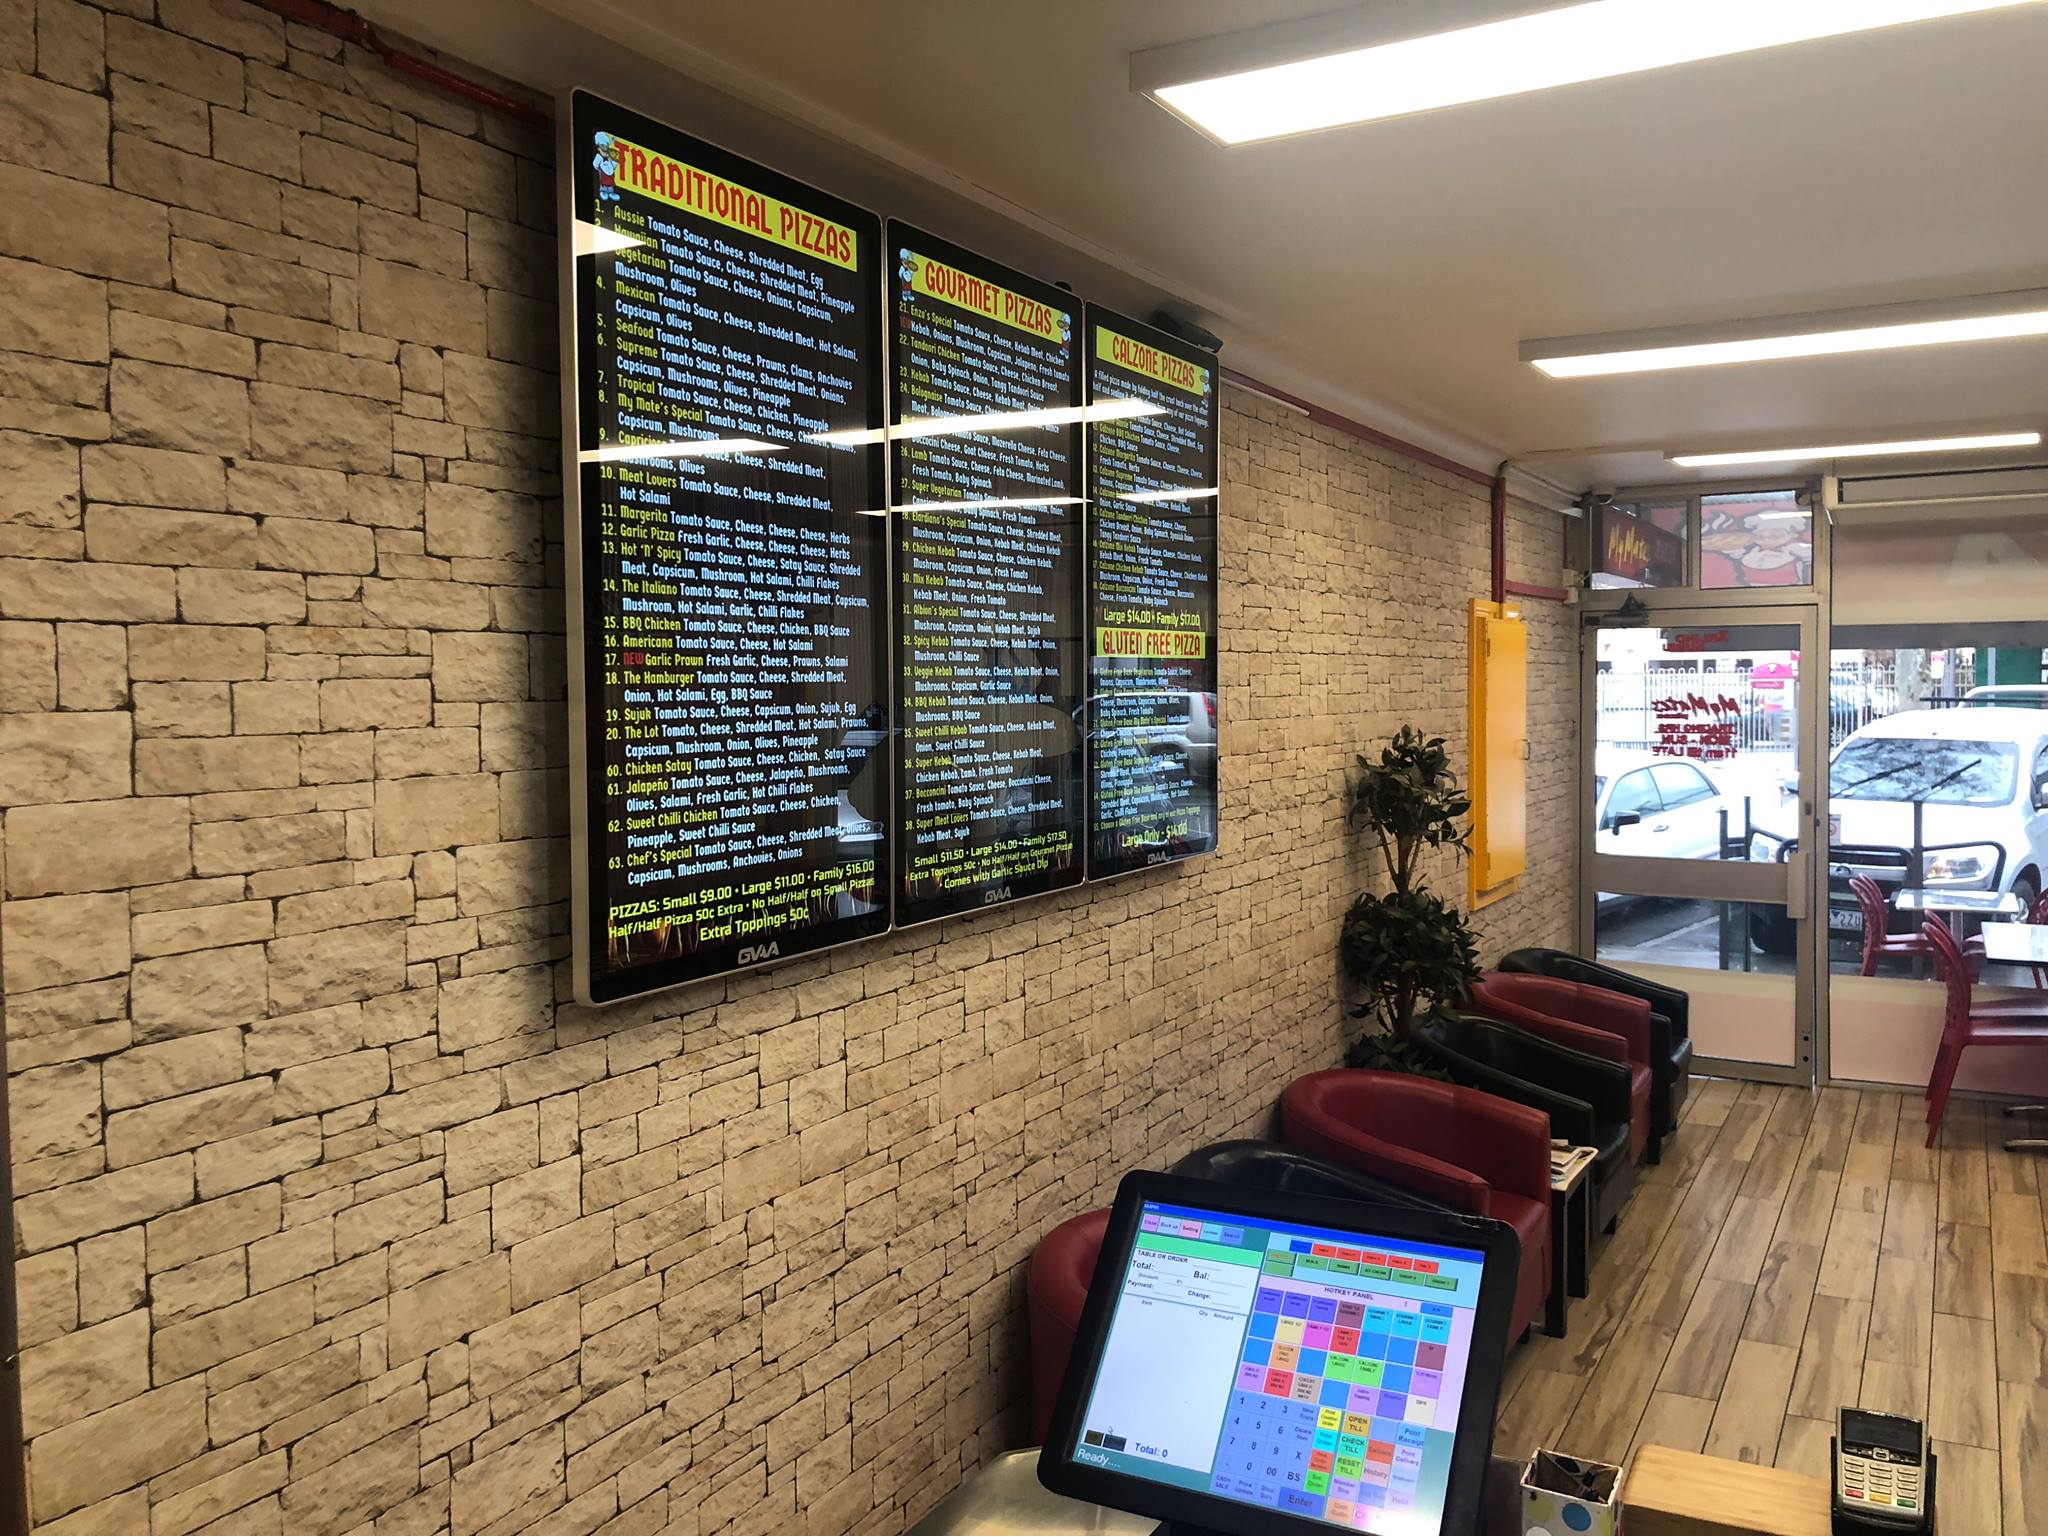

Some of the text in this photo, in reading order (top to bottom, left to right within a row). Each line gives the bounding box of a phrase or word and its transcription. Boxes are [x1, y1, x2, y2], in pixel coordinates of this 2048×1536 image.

[614, 140, 851, 263] TRADITIONAL PIZZAS
[594, 197, 824, 290] 1. Aussie Tomato Sauce, Cheese, Shredded Meat, Egg
[925, 261, 1052, 335] GOURMET PIZZAS
[597, 313, 852, 390] 5. Seafood Tomato Sauce, Cheese, Prawns, Clams, Anchovies
[1112, 335, 1195, 388] CALZONE PIZZAS
[1104, 608, 1200, 627] Large $14.00 Family $17.00
[1103, 630, 1200, 656] GLUTEN FREE PIZZA
[604, 653, 620, 665] 17.
[645, 654, 672, 665] Garlic
[675, 654, 703, 666] Prawn
[706, 655, 730, 666] Fresh
[733, 655, 759, 667] Garlic,
[761, 655, 791, 667] Cheese,
[793, 656, 823, 668] Prawns,
[825, 656, 848, 666] Salami
[607, 747, 865, 777] 60. Chicken Satay Tomato Sauce, Cheese, Chicken, Satay Sauce
[1122, 834, 1143, 848] Large
[1144, 829, 1160, 843] Only
[915, 831, 1066, 867] Small $11.50 Large $14.00 Family $17.50
[628, 848, 803, 887] Capsicum, Mushrooms, Anchovies, Onions
[610, 860, 874, 919] PIZZAS: Small $9.00 Large $11.00 Family $16.00
[609, 917, 662, 938] Half/Half
[665, 911, 693, 927] Pizza
[718, 902, 743, 916] Extra
[752, 898, 765, 909] No
[768, 889, 809, 906] Half/Half
[811, 889, 821, 898] on
[824, 882, 847, 895] Small
[849, 877, 874, 890] Pizzas
[701, 923, 731, 941] Extra
[735, 911, 787, 936] Toppings
[1137, 1250, 1188, 1263] TABLE OR ORDER
[1132, 1260, 1210, 1280] Total: Bal:
[1127, 1279, 1212, 1300] Payment: Change:
[1324, 1287, 1374, 1300] HOTKEY PANEL
[1260, 1401, 1266, 1409] 2
[1282, 1405, 1288, 1414] 3
[1234, 1417, 1240, 1425] 4
[1255, 1421, 1261, 1430] 5
[1347, 1416, 1368, 1425] OPEN
[1278, 1426, 1284, 1434] 6
[1349, 1423, 1364, 1433] TILL
[1230, 1437, 1236, 1445] 7
[1251, 1441, 1257, 1450] 8
[1341, 1436, 1365, 1446] CHECK
[1135, 1442, 1168, 1458] Total: 0
[1273, 1446, 1279, 1455] 9
[1344, 1445, 1359, 1454] TILL
[1246, 1462, 1252, 1471] 0
[1337, 1456, 1361, 1467] RESET
[1266, 1467, 1277, 1477] 00
[1340, 1465, 1354, 1475] TILL
[1287, 1472, 1301, 1482] BS
[1288, 1494, 1313, 1508] Enter
